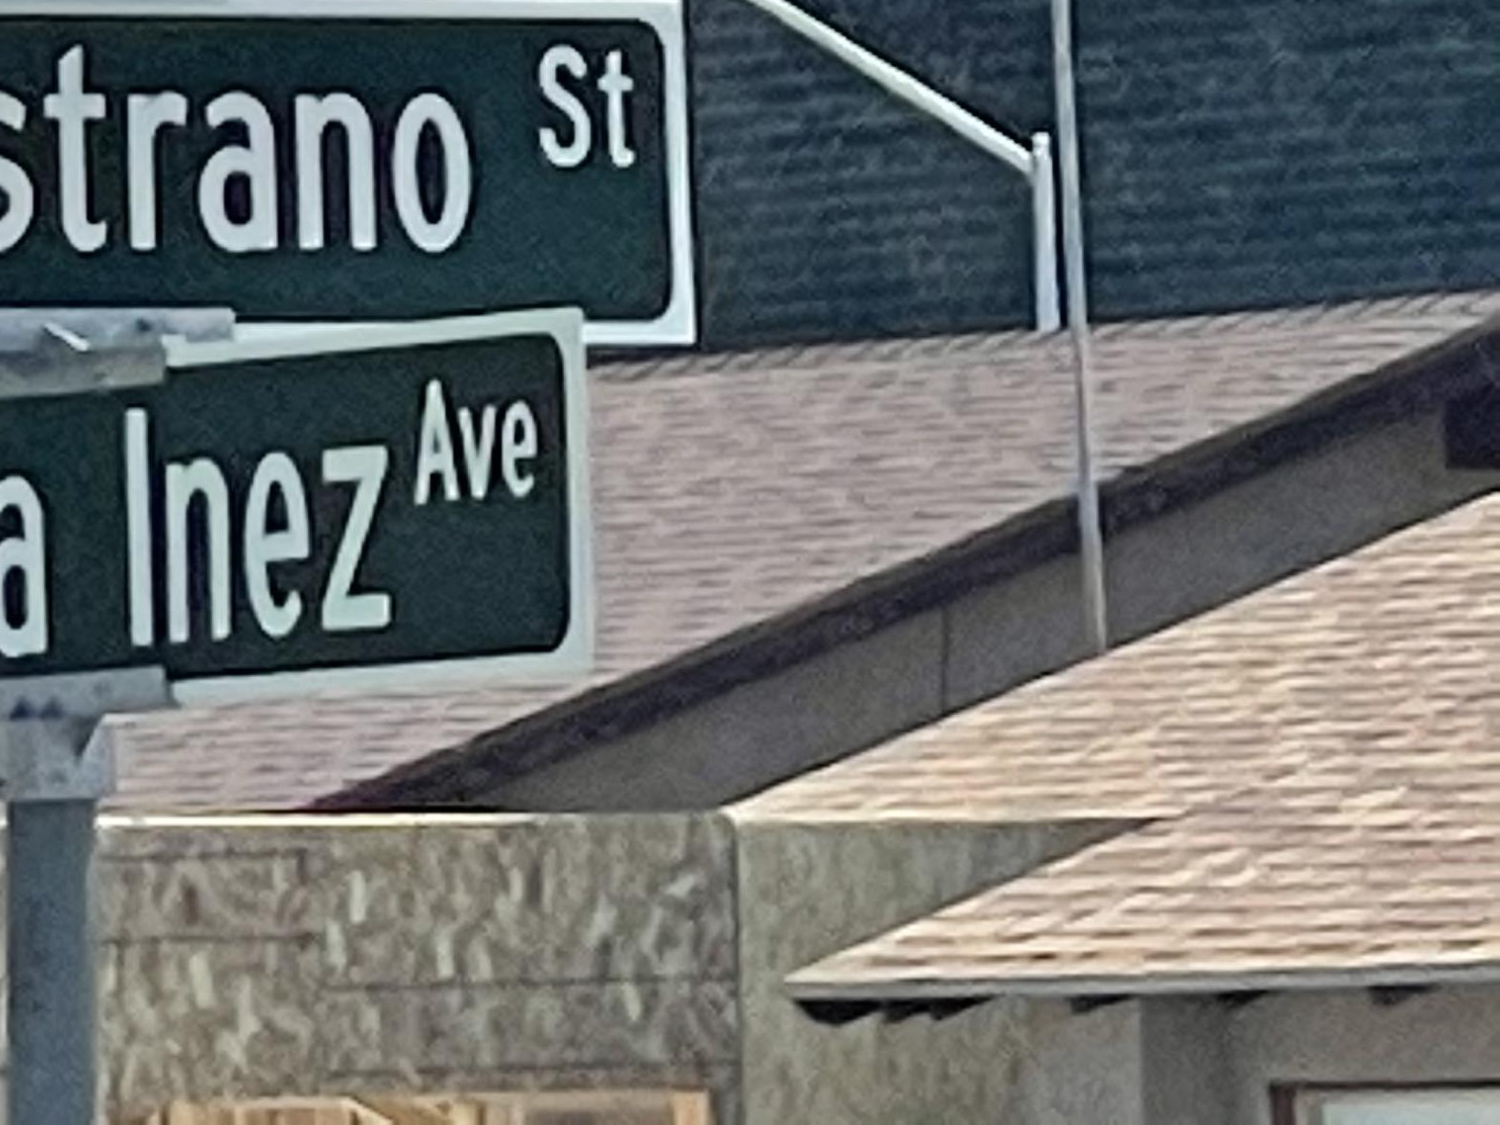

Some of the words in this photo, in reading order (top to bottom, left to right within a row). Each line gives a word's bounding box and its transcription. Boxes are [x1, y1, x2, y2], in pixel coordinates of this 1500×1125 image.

[538, 44, 636, 169] St
[124, 407, 391, 647] Inez
[413, 379, 538, 506] Ave
